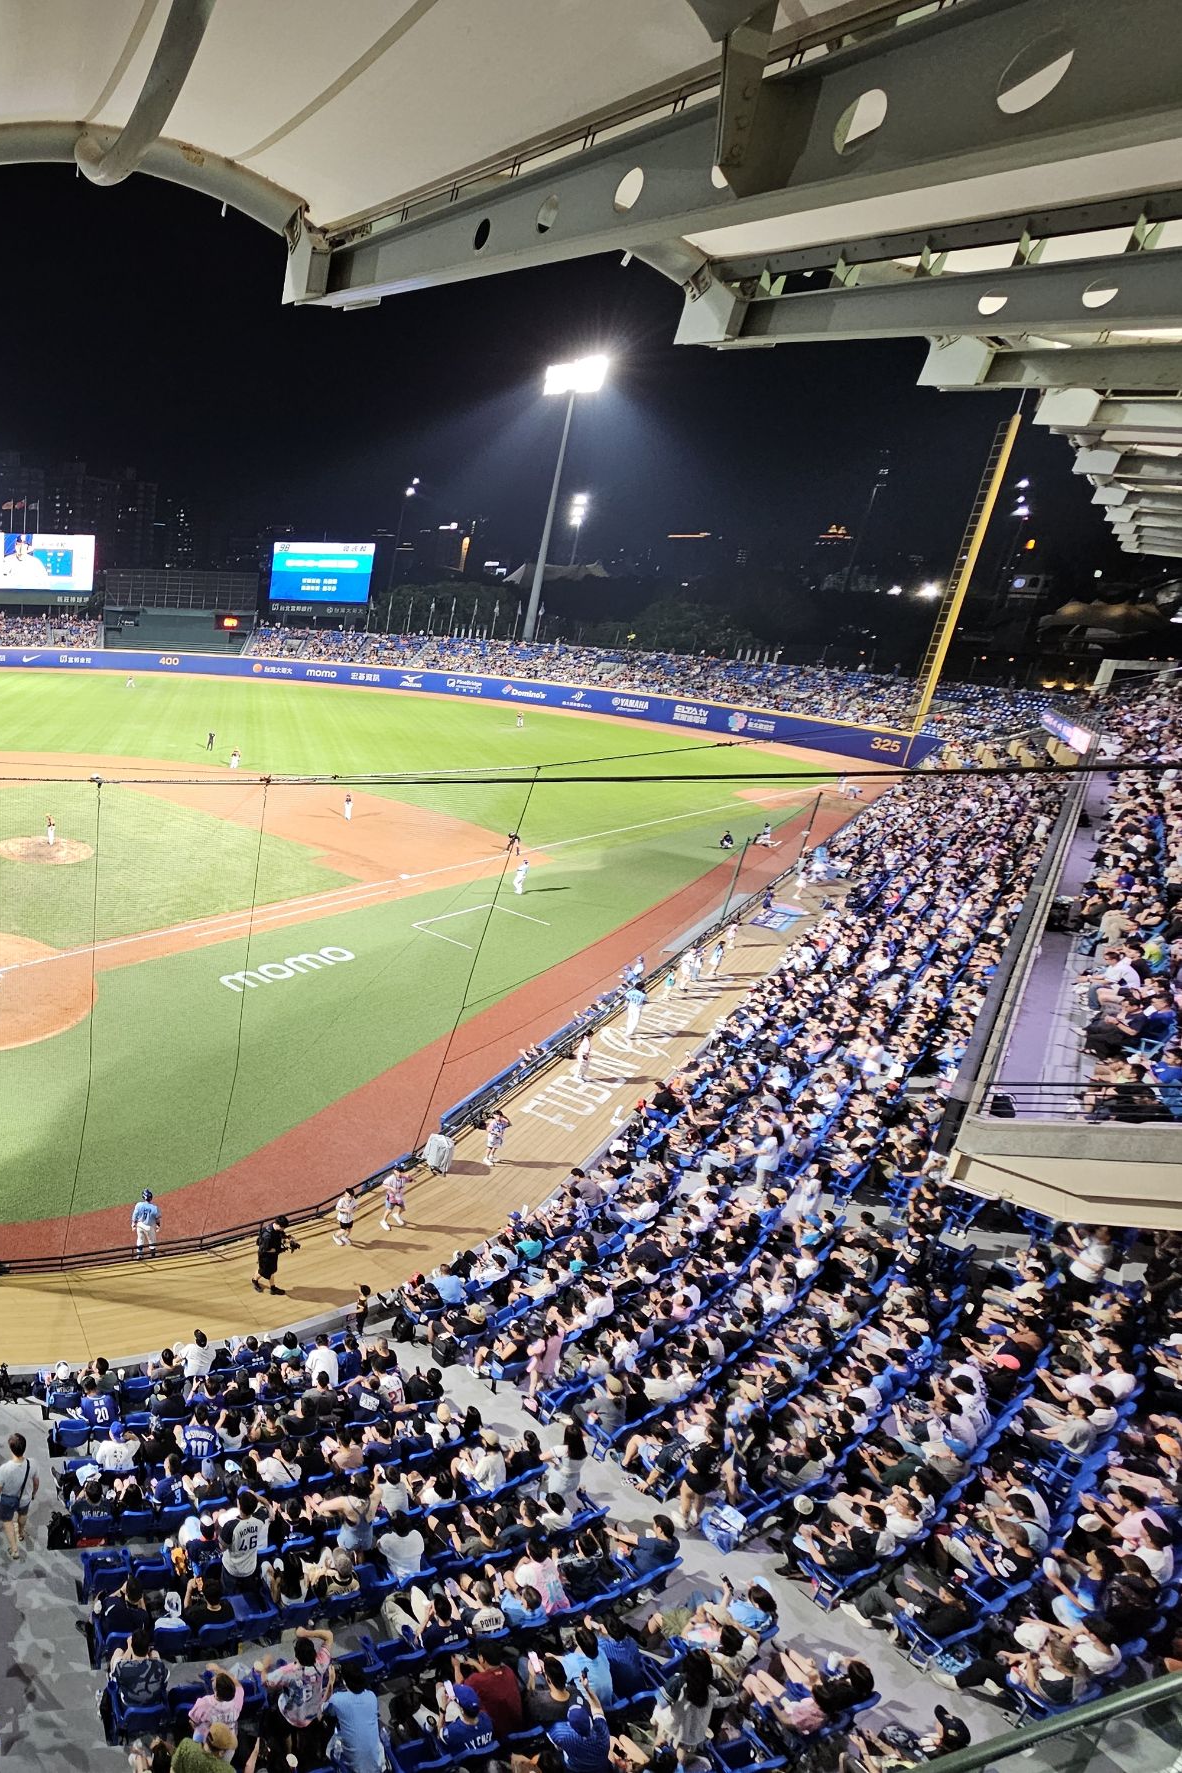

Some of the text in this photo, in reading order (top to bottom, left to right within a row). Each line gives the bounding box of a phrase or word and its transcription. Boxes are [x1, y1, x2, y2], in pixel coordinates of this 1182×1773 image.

[159, 656, 180, 666] 400
[306, 669, 337, 678] momo
[511, 689, 546, 699] Domino's
[620, 698, 649, 709] YAMAHA
[871, 737, 901, 753] 325
[219, 946, 356, 993] momo
[389, 1388, 405, 1405] 27
[94, 1406, 110, 1424] 20
[239, 1525, 258, 1539] HONDA
[238, 1535, 258, 1552] 46
